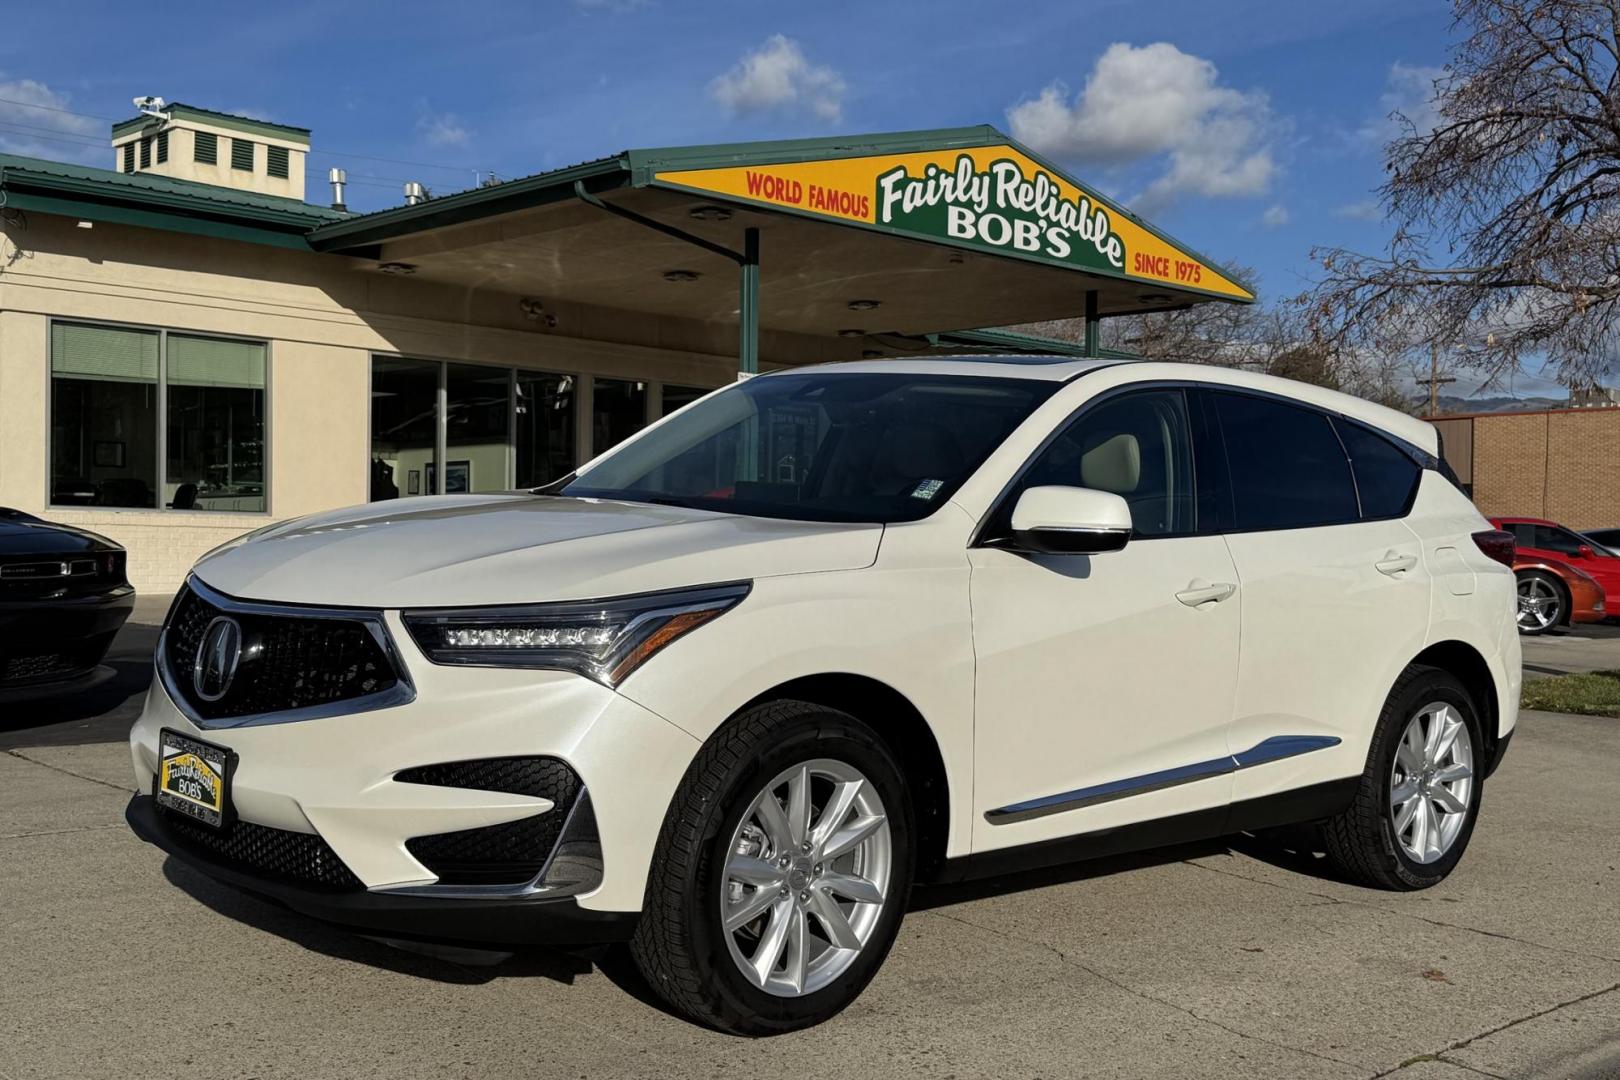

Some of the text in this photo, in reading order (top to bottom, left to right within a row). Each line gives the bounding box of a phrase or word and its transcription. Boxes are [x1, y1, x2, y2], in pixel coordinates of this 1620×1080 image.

[746, 171, 869, 218] WORLD FAMOUS
[880, 157, 1123, 267] Fairly Reliable
[948, 205, 1071, 258] BOB'S
[1134, 252, 1201, 283] SINCE 1975
[178, 778, 202, 800] BOB'S
